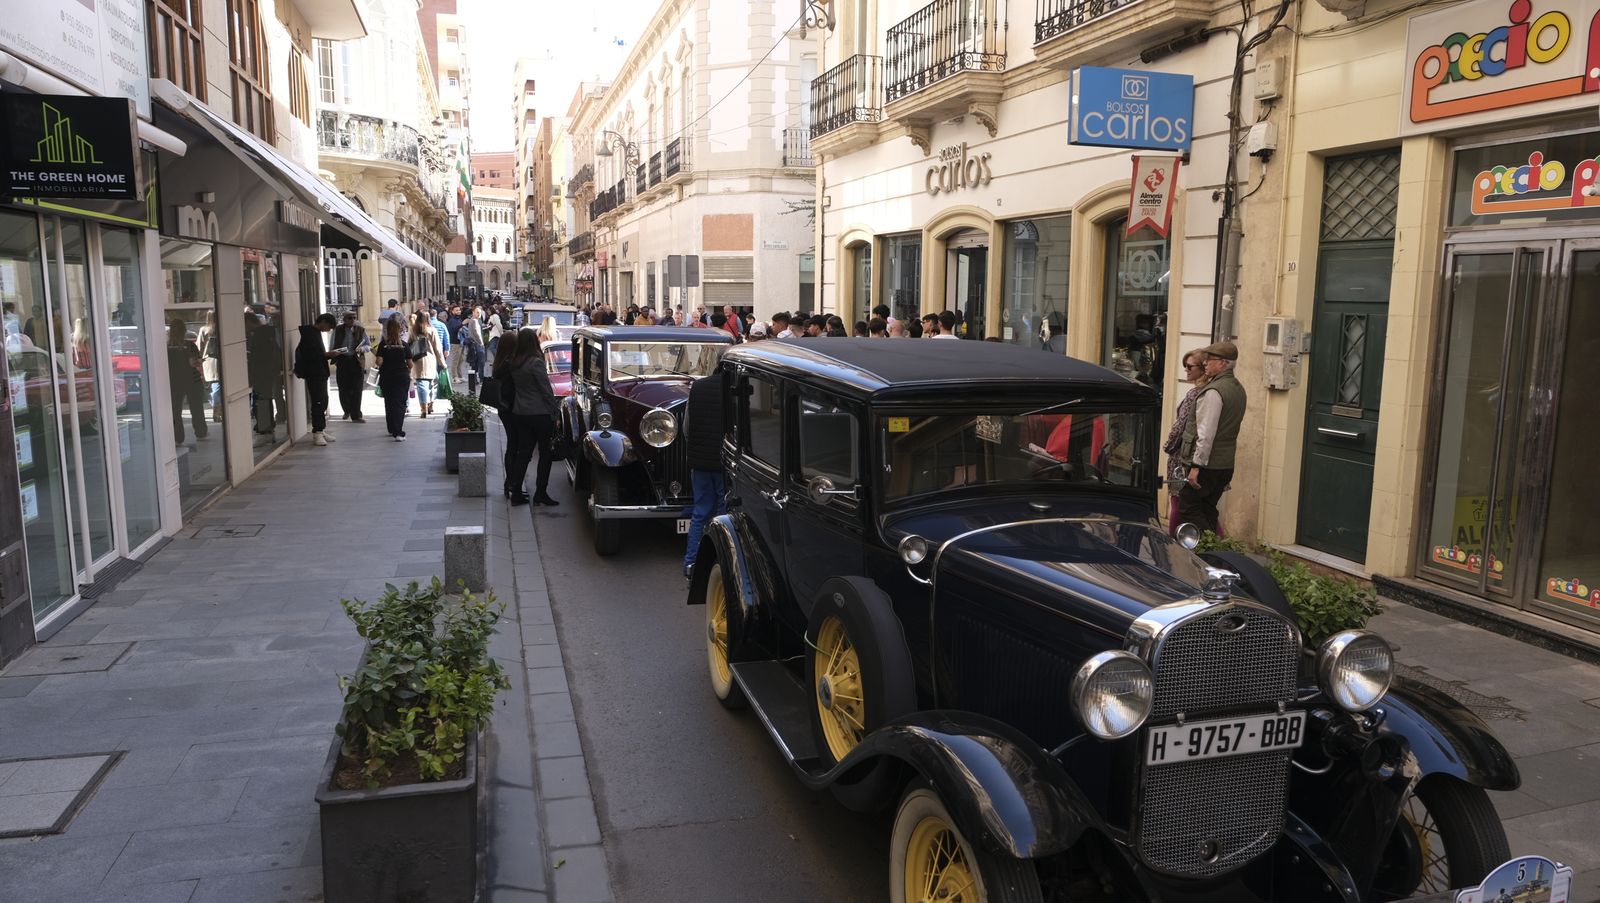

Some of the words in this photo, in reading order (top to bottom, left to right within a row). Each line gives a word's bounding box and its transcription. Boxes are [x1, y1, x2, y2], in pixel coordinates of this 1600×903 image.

[1106, 101, 1144, 114] BOLSOS
[1083, 104, 1186, 143] carlos
[926, 142, 992, 196] carlos
[10, 171, 35, 181] THE
[39, 172, 83, 182] GREEN
[87, 174, 126, 183] HOME
[33, 185, 105, 193] INMOBILIARIA
[1288, 262, 1296, 272] 10
[1517, 863, 1526, 882] 5
